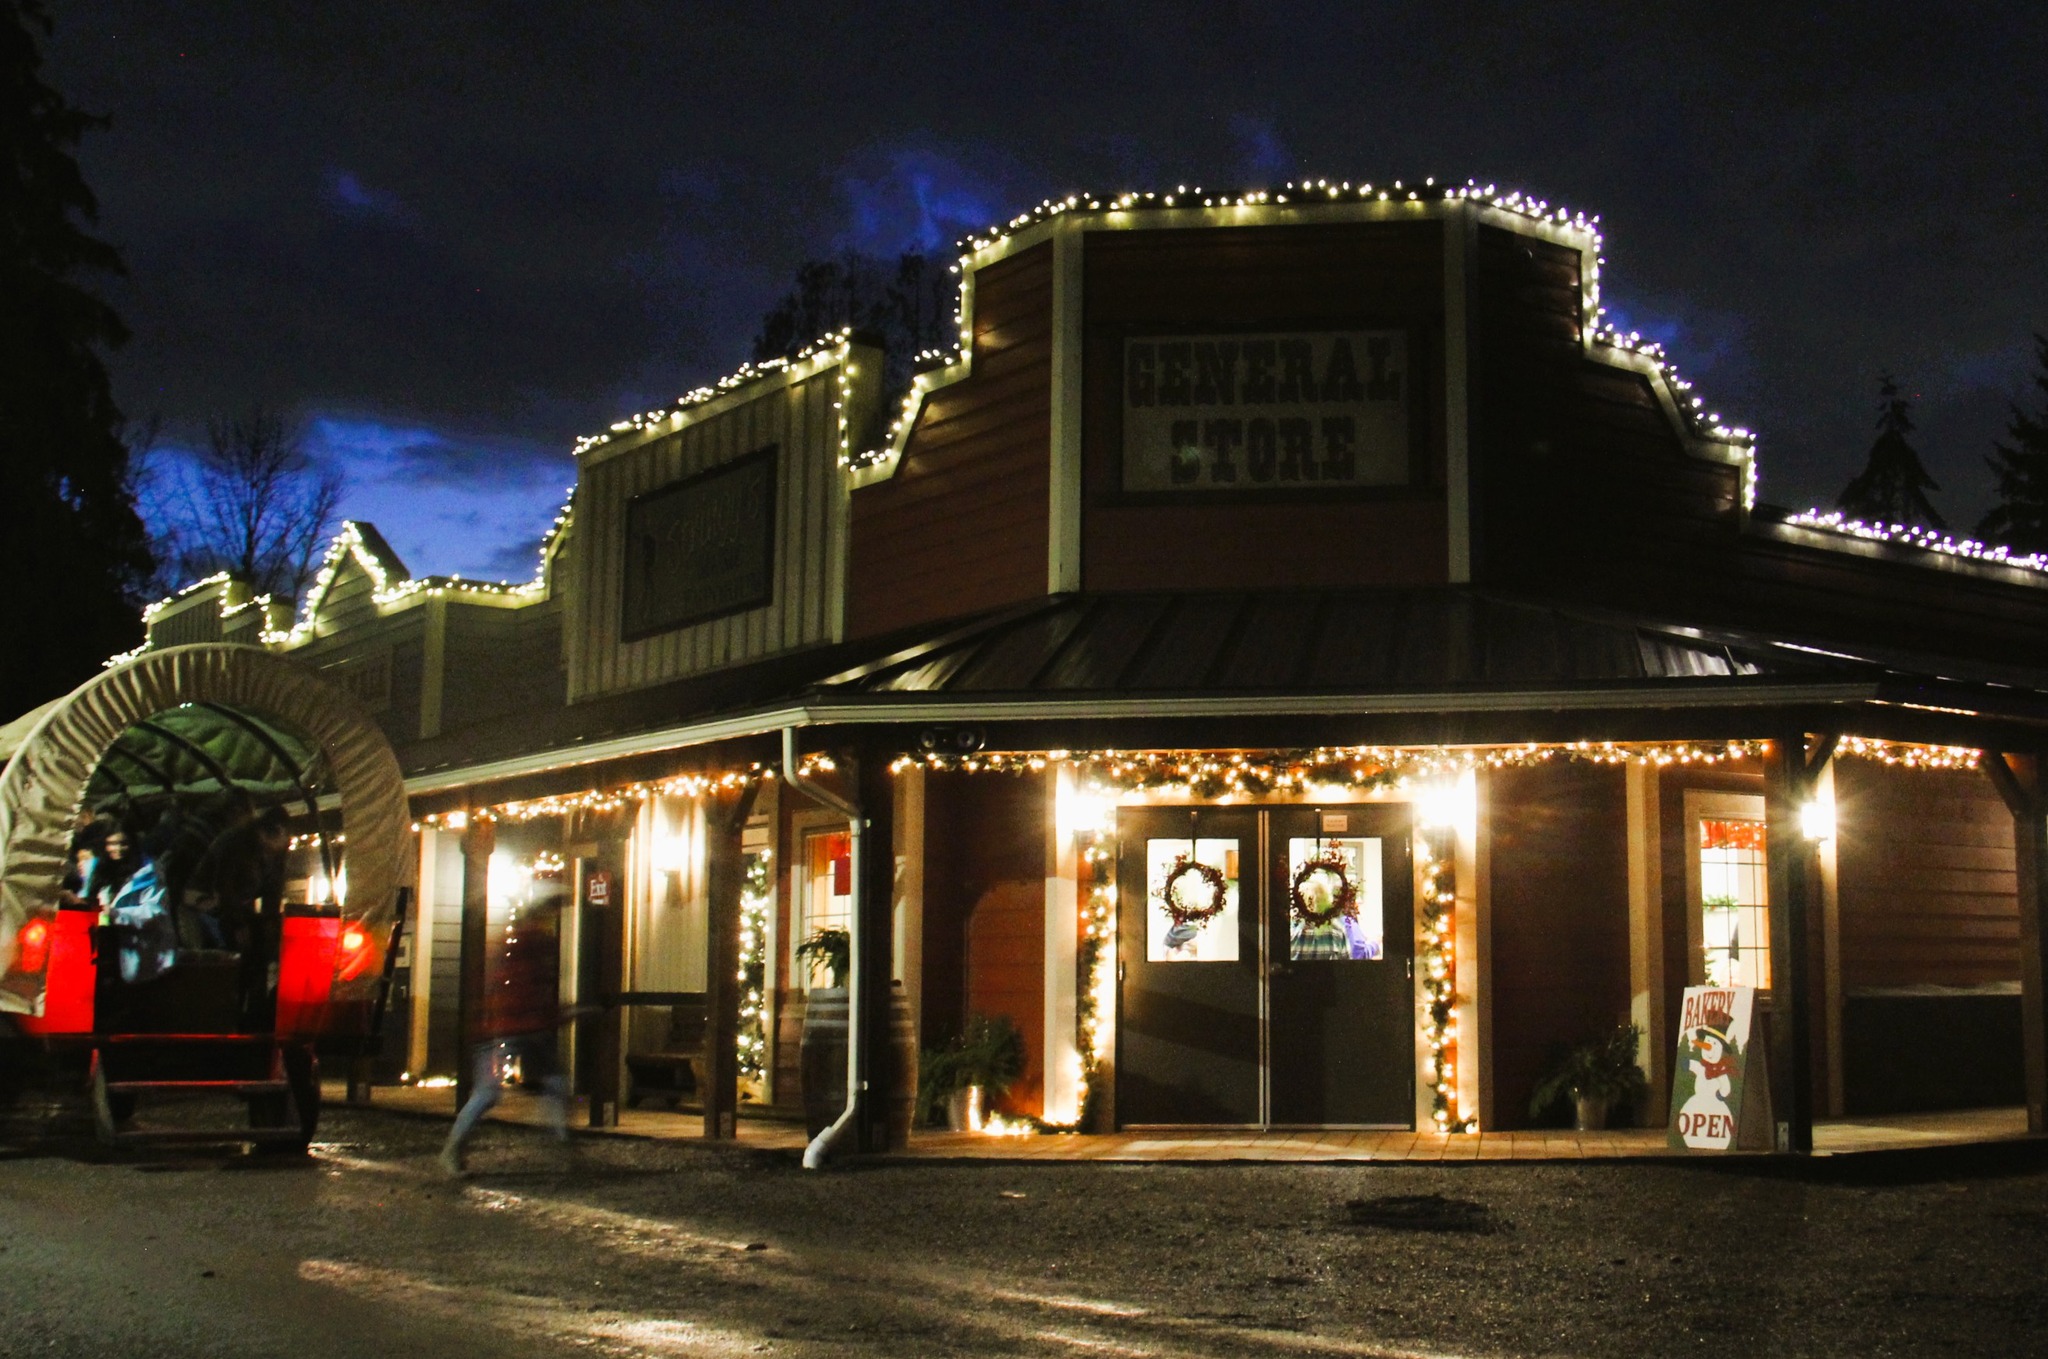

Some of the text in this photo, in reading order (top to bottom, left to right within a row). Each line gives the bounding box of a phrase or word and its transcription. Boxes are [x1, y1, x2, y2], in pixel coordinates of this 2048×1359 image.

[1128, 337, 1401, 408] GENERAL
[1170, 416, 1355, 484] STORE
[1684, 991, 1736, 1029] BAKERY
[1676, 1113, 1737, 1139] OPEN
